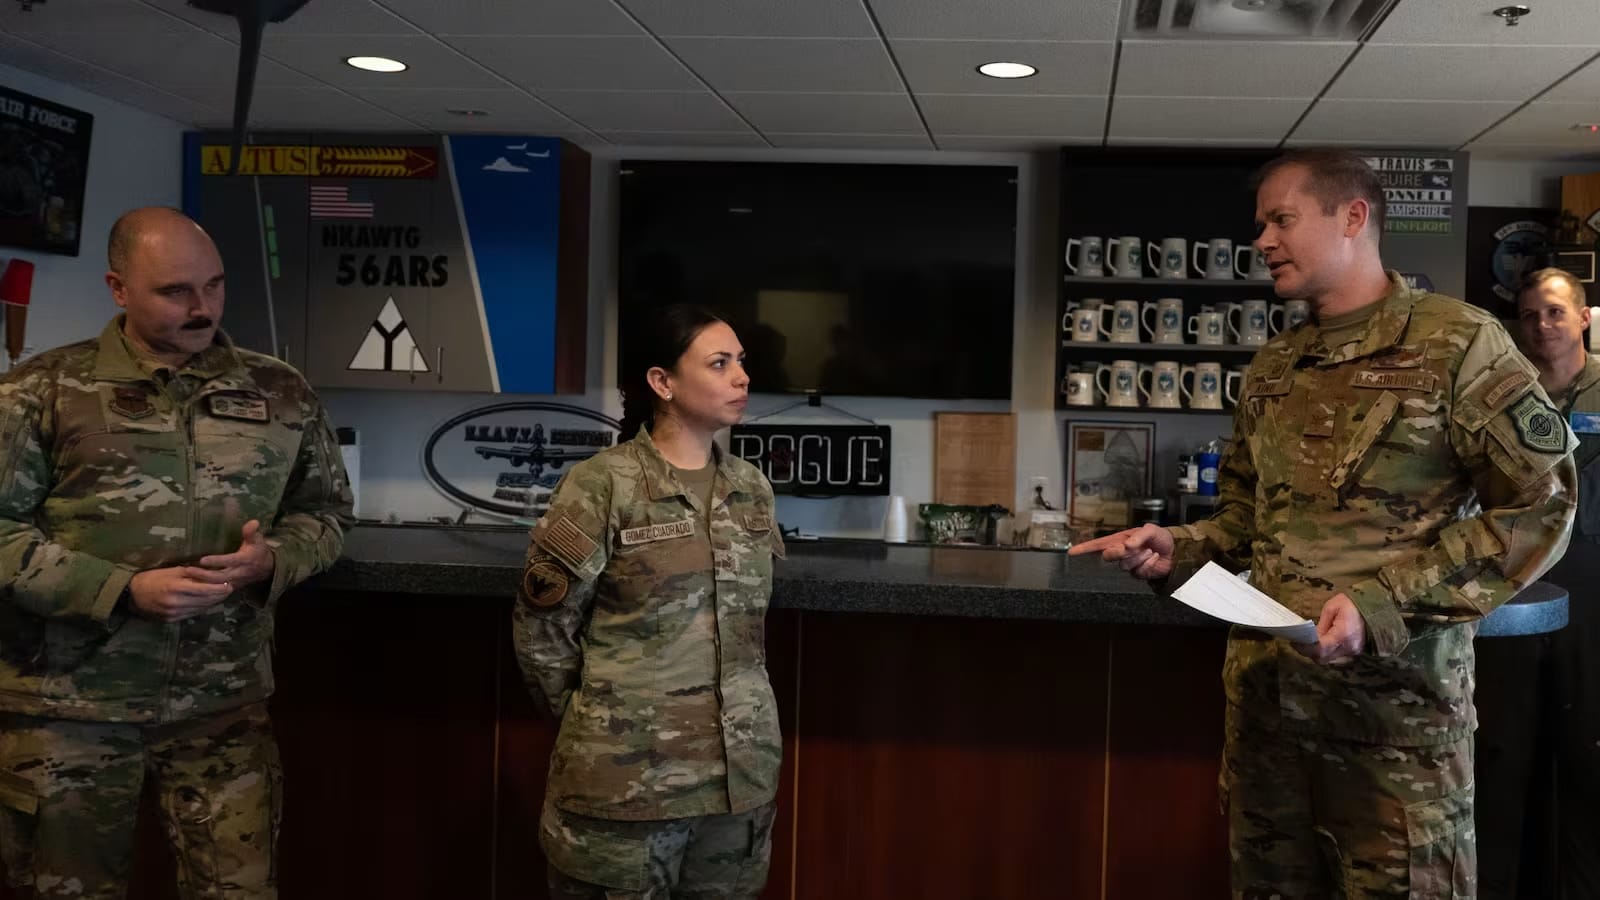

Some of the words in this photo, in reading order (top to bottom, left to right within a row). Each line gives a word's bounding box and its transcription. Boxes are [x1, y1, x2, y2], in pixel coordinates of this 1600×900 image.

[29, 105, 77, 134] FORCE
[208, 147, 307, 173] ATUS
[1379, 158, 1425, 170] TRAVIS
[321, 224, 421, 249] NKAWTG
[335, 253, 449, 287] 56ARS
[732, 434, 883, 486] ROGUE
[625, 528, 651, 543] GOMEZ
[652, 521, 691, 540] CUADRADO
